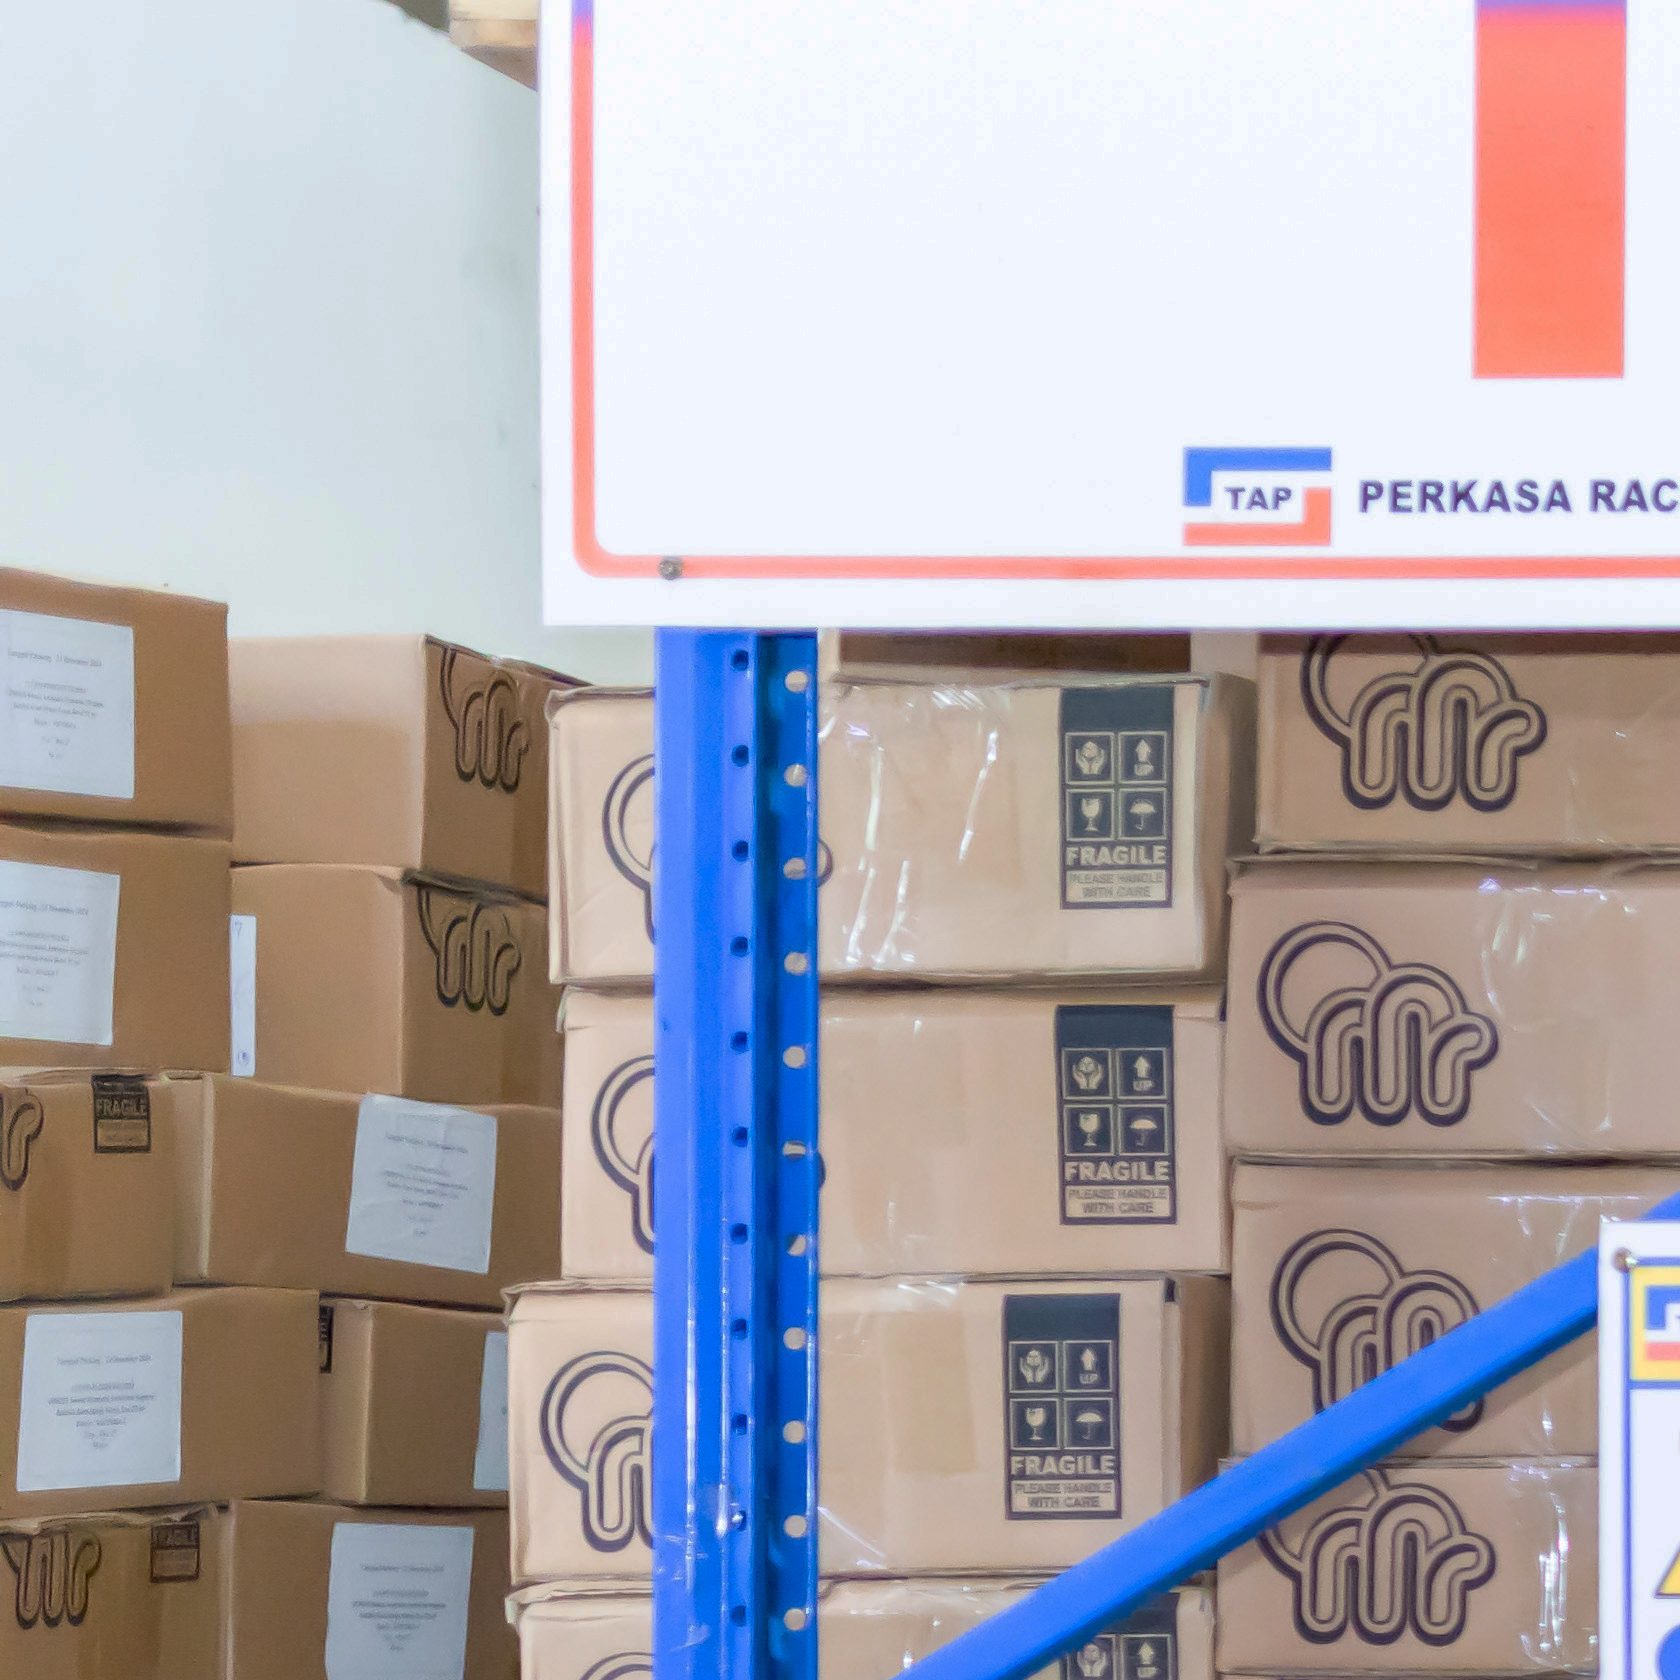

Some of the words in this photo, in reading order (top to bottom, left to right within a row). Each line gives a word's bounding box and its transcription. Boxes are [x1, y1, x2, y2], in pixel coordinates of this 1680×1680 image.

[1225, 486, 1291, 510] TAP
[1358, 478, 1572, 513] PERKASA
[1066, 845, 1167, 866] FRAGILE
[1069, 871, 1114, 883] PLEASE
[1118, 871, 1164, 884] HANDLE
[1082, 885, 1113, 897] WITH
[1116, 885, 1151, 897] CARE
[1132, 1079, 1153, 1092] UP
[1064, 1160, 1169, 1181] FRAGILE
[1069, 1187, 1117, 1200] PLEASE
[1120, 1187, 1166, 1200] HANDLE
[1082, 1202, 1114, 1214] WITH
[1119, 1202, 1154, 1214] CARE
[1010, 1455, 1116, 1475] FRAGILE
[1014, 1481, 1061, 1494] PLEASE
[1064, 1481, 1112, 1494] HANDLE
[1027, 1496, 1061, 1508] WITH
[1065, 1496, 1100, 1508] CARE
